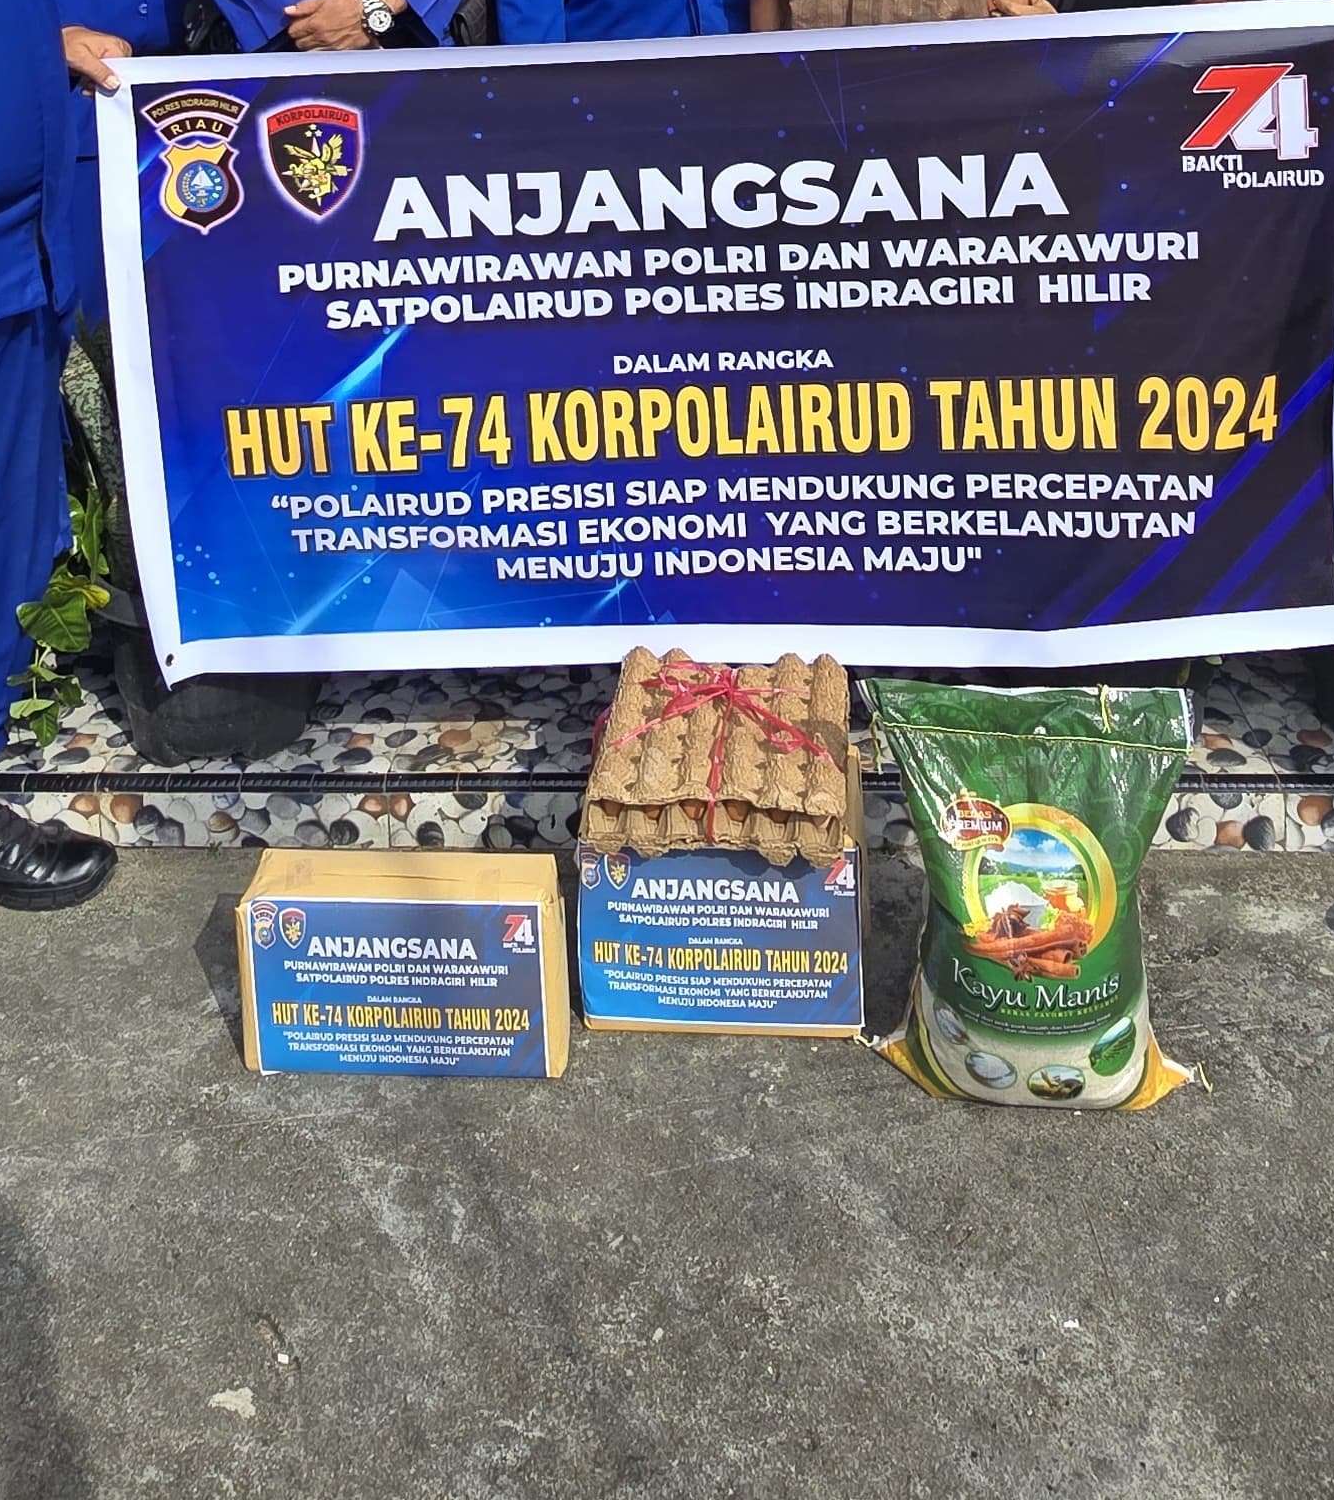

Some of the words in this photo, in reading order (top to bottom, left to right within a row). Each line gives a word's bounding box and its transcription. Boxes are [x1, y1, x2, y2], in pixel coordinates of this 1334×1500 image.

[152, 101, 181, 119] POLRES
[276, 107, 350, 126] KORPOLAIRUD
[1180, 62, 1319, 160] 74
[170, 119, 223, 135] RIAU
[1182, 154, 1243, 172] BAKTI
[1223, 170, 1325, 189] POLAIRUD
[373, 153, 1069, 244] ANJANGSANA
[278, 250, 633, 293] PURNAWIRAWAN
[644, 244, 766, 277] POLRI
[779, 240, 869, 272] DAN
[883, 231, 1200, 267] WARAKAWURI
[326, 288, 610, 329] SATPOLAIRUD
[625, 283, 785, 316] POLRES
[797, 275, 1014, 309] INDRAGIRI
[1039, 273, 1152, 303] HILIR
[614, 353, 710, 375] DALAM
[718, 349, 834, 371] RANGKA
[224, 405, 334, 478] HUT
[352, 395, 512, 473] KE-74
[530, 379, 912, 464] KORPOLAIRUD
[929, 378, 1117, 451] TAHUN
[1138, 375, 1279, 451] 2024
[482, 483, 614, 515] PRESISI
[625, 481, 707, 508] SIAP
[718, 474, 954, 504] MENDUKUNG
[966, 473, 1214, 501] PERCEPATAN
[291, 521, 568, 553] TRANSFORMASI
[578, 514, 746, 544] EKONOMI
[769, 511, 867, 538] YANG
[877, 510, 1196, 539] BERKELANJUTAN
[496, 552, 643, 581] MENUJU
[654, 546, 853, 577] INDONESIA
[863, 545, 981, 573] MAJU"
[631, 878, 800, 903] ANJANGSANA
[607, 901, 695, 915] PURNAWIRAWAN
[698, 904, 728, 915] POLRI
[730, 905, 753, 916] DAN
[755, 906, 830, 918] WARAKAWURI
[502, 914, 534, 946] 74
[619, 914, 690, 927] SATPOLAIRUD
[692, 916, 732, 928] POLRES
[733, 918, 787, 929] INDRAGIRI
[791, 919, 818, 930] HILIR
[307, 935, 478, 960] ANJANGSANA
[688, 937, 713, 945] DALAM
[594, 941, 620, 964] HUT
[624, 943, 663, 968] KE-74
[667, 946, 762, 972] KORPOLAIRUD
[766, 949, 810, 973] TAHUN
[813, 950, 849, 974] 2024
[284, 960, 372, 973] PURNAWIRAWAN
[374, 963, 405, 974] POLRI
[407, 964, 431, 974] DAN
[432, 964, 509, 975] WARAKAWURI
[295, 973, 368, 984] SATPOLAIRUD
[370, 975, 410, 986] POLRES
[411, 976, 466, 987] INDRAGIRI
[470, 976, 498, 987] HILIR
[655, 974, 689, 985] PRESISI
[690, 976, 711, 986] SIAP
[713, 977, 771, 987] MENDUKUNG
[773, 978, 832, 989] PERCEPATAN
[952, 957, 1027, 1010] Kayu
[1034, 974, 1120, 1009] Manis
[367, 995, 392, 1003] DALAM
[608, 981, 677, 996] TRANSFORMASI
[678, 987, 721, 997] EKONOMI
[724, 988, 749, 998] YANG
[752, 988, 828, 999] BERKELANJUTAN
[657, 996, 695, 1007] MENUJU
[697, 998, 746, 1008] INDONESIA
[272, 1002, 299, 1025] HUT
[303, 1002, 343, 1027] KE-74
[347, 1004, 442, 1029] KORPOLAIRUD
[445, 1007, 491, 1030] TAHUN
[494, 1008, 530, 1031] 2024
[335, 1033, 369, 1042] PRESISI
[371, 1034, 392, 1043] SIAP
[393, 1034, 453, 1045] MENDUKUNG
[455, 1036, 514, 1046] PERCEPATAN
[288, 1042, 358, 1053] TRANSFORMASI
[360, 1044, 402, 1053] EKONOMI
[406, 1045, 431, 1055] YANG
[433, 1046, 511, 1057] BERKELANJUTAN
[339, 1054, 377, 1063] MENUJU
[379, 1055, 429, 1065] INDONESIA
